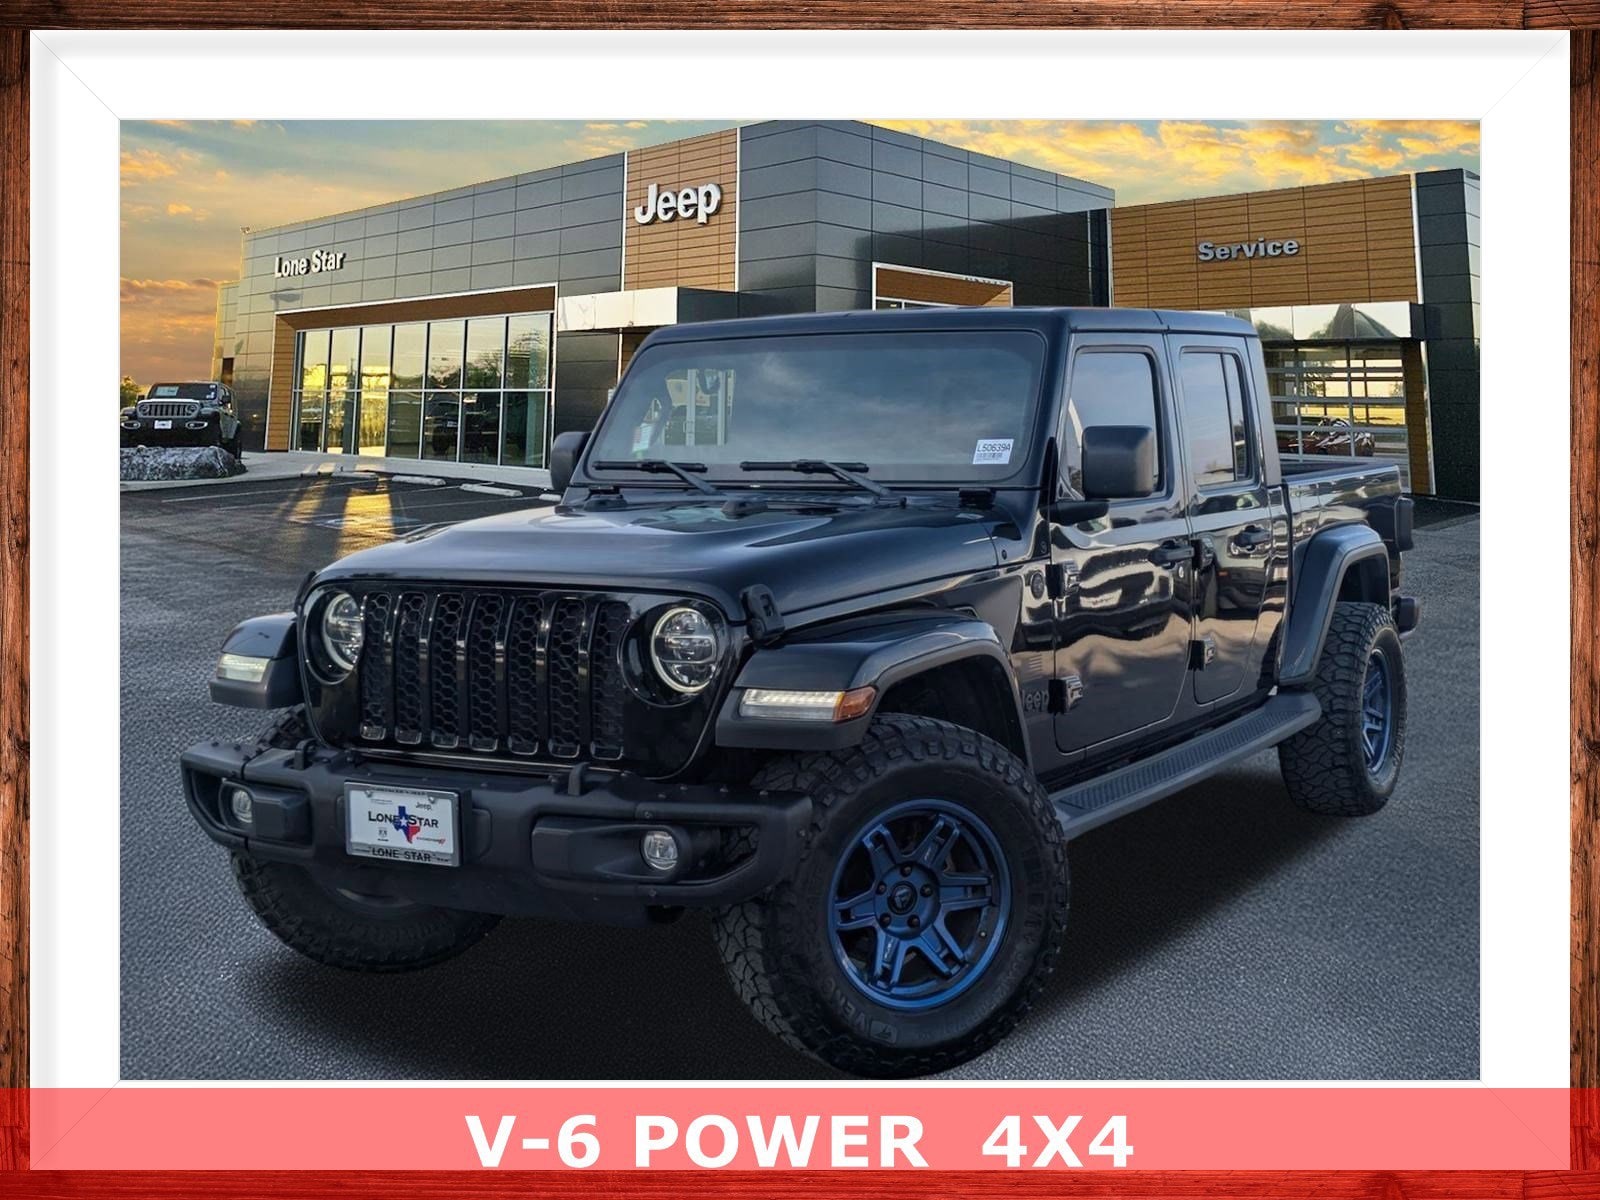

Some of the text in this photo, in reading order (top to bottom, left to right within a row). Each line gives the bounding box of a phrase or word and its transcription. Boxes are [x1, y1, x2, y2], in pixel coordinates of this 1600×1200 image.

[634, 183, 723, 225] Jeep
[1198, 237, 1299, 261] Service
[275, 249, 346, 278] Lone Star
[372, 847, 399, 859] LONE
[404, 850, 431, 862] STAR
